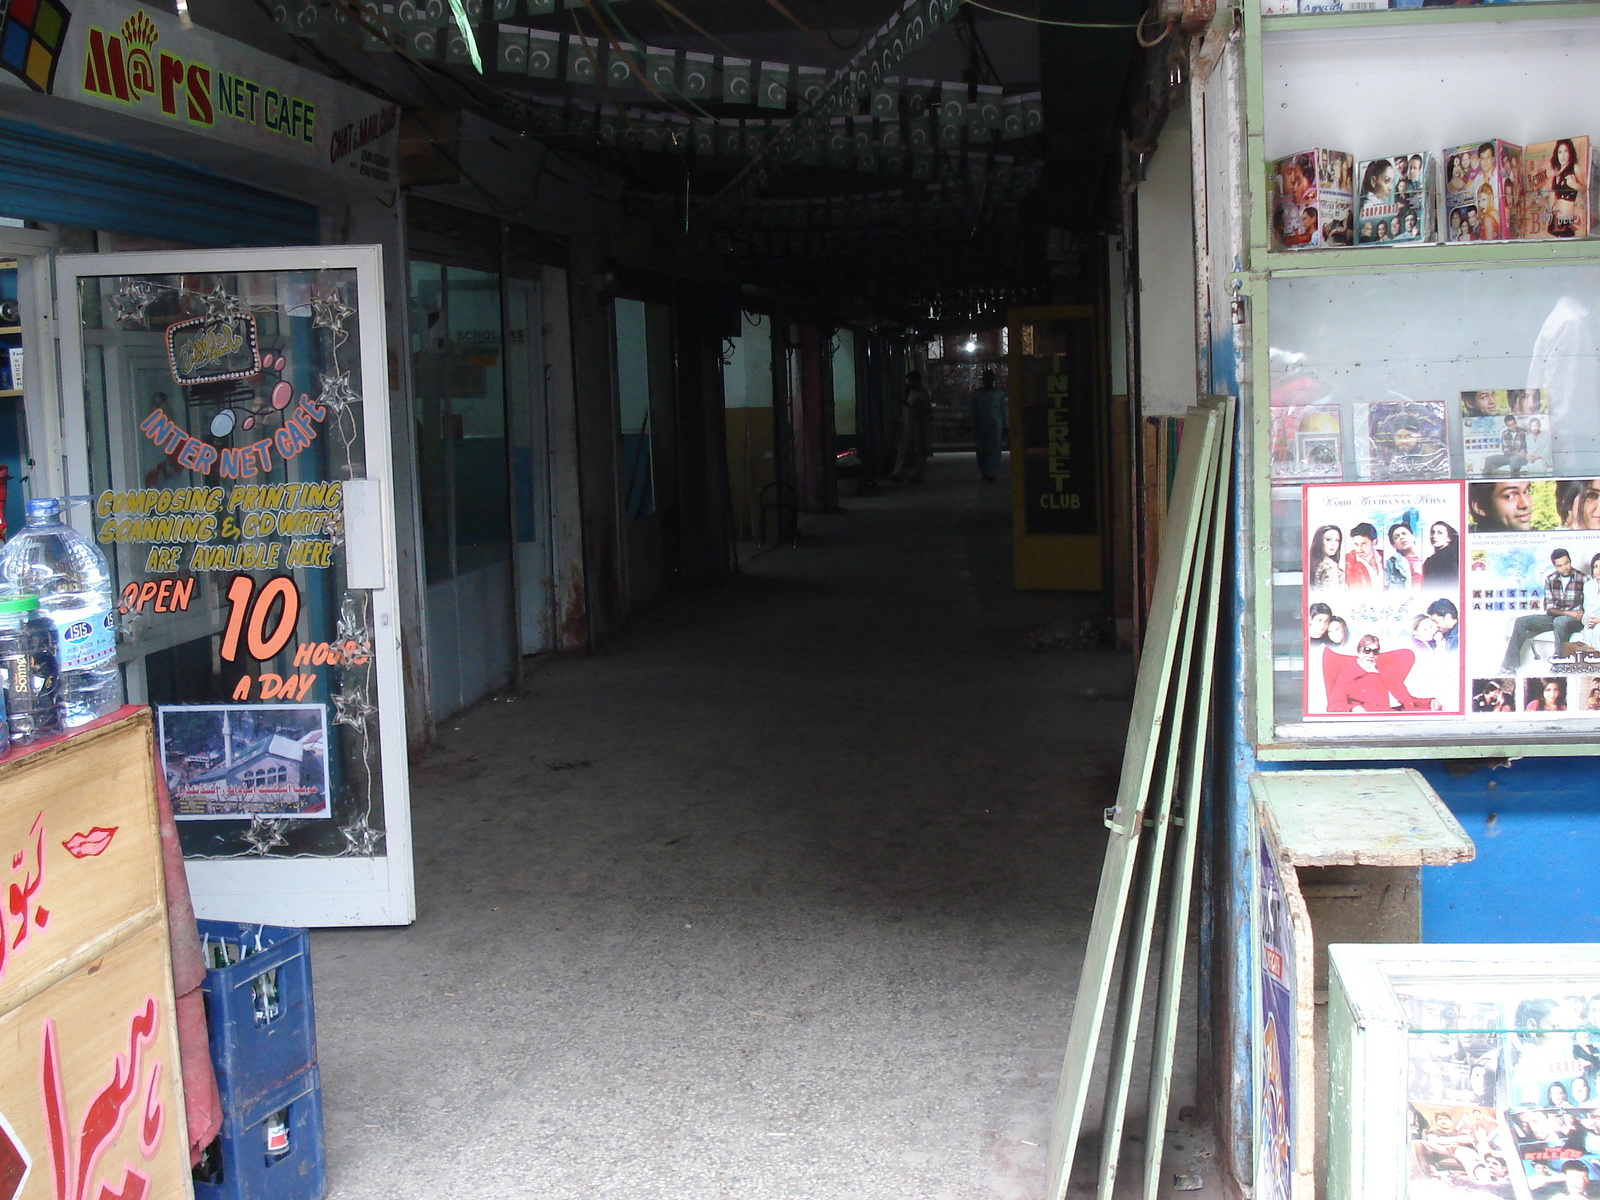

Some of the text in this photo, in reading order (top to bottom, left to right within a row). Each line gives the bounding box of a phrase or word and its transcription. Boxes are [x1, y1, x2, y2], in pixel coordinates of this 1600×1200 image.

[217, 72, 260, 125] NET
[263, 90, 315, 145] CAFE
[1361, 203, 1400, 218] CORPORATE
[456, 330, 524, 340] SCHOLRS
[141, 394, 327, 479] INTER NET CAFE
[1047, 354, 1070, 492] INTERNET
[1040, 493, 1081, 510] CLUB
[242, 511, 278, 538] CD
[145, 545, 181, 573] ARE
[190, 542, 281, 572] AVALIBLE
[118, 577, 195, 614] OPEN
[1473, 588, 1540, 598] AHISTA
[1473, 601, 1541, 611] AHISTA
[70, 622, 89, 639] ISIS
[220, 575, 300, 662] 10
[232, 673, 317, 701] A DAY
[1525, 1149, 1582, 1161] KILLER
